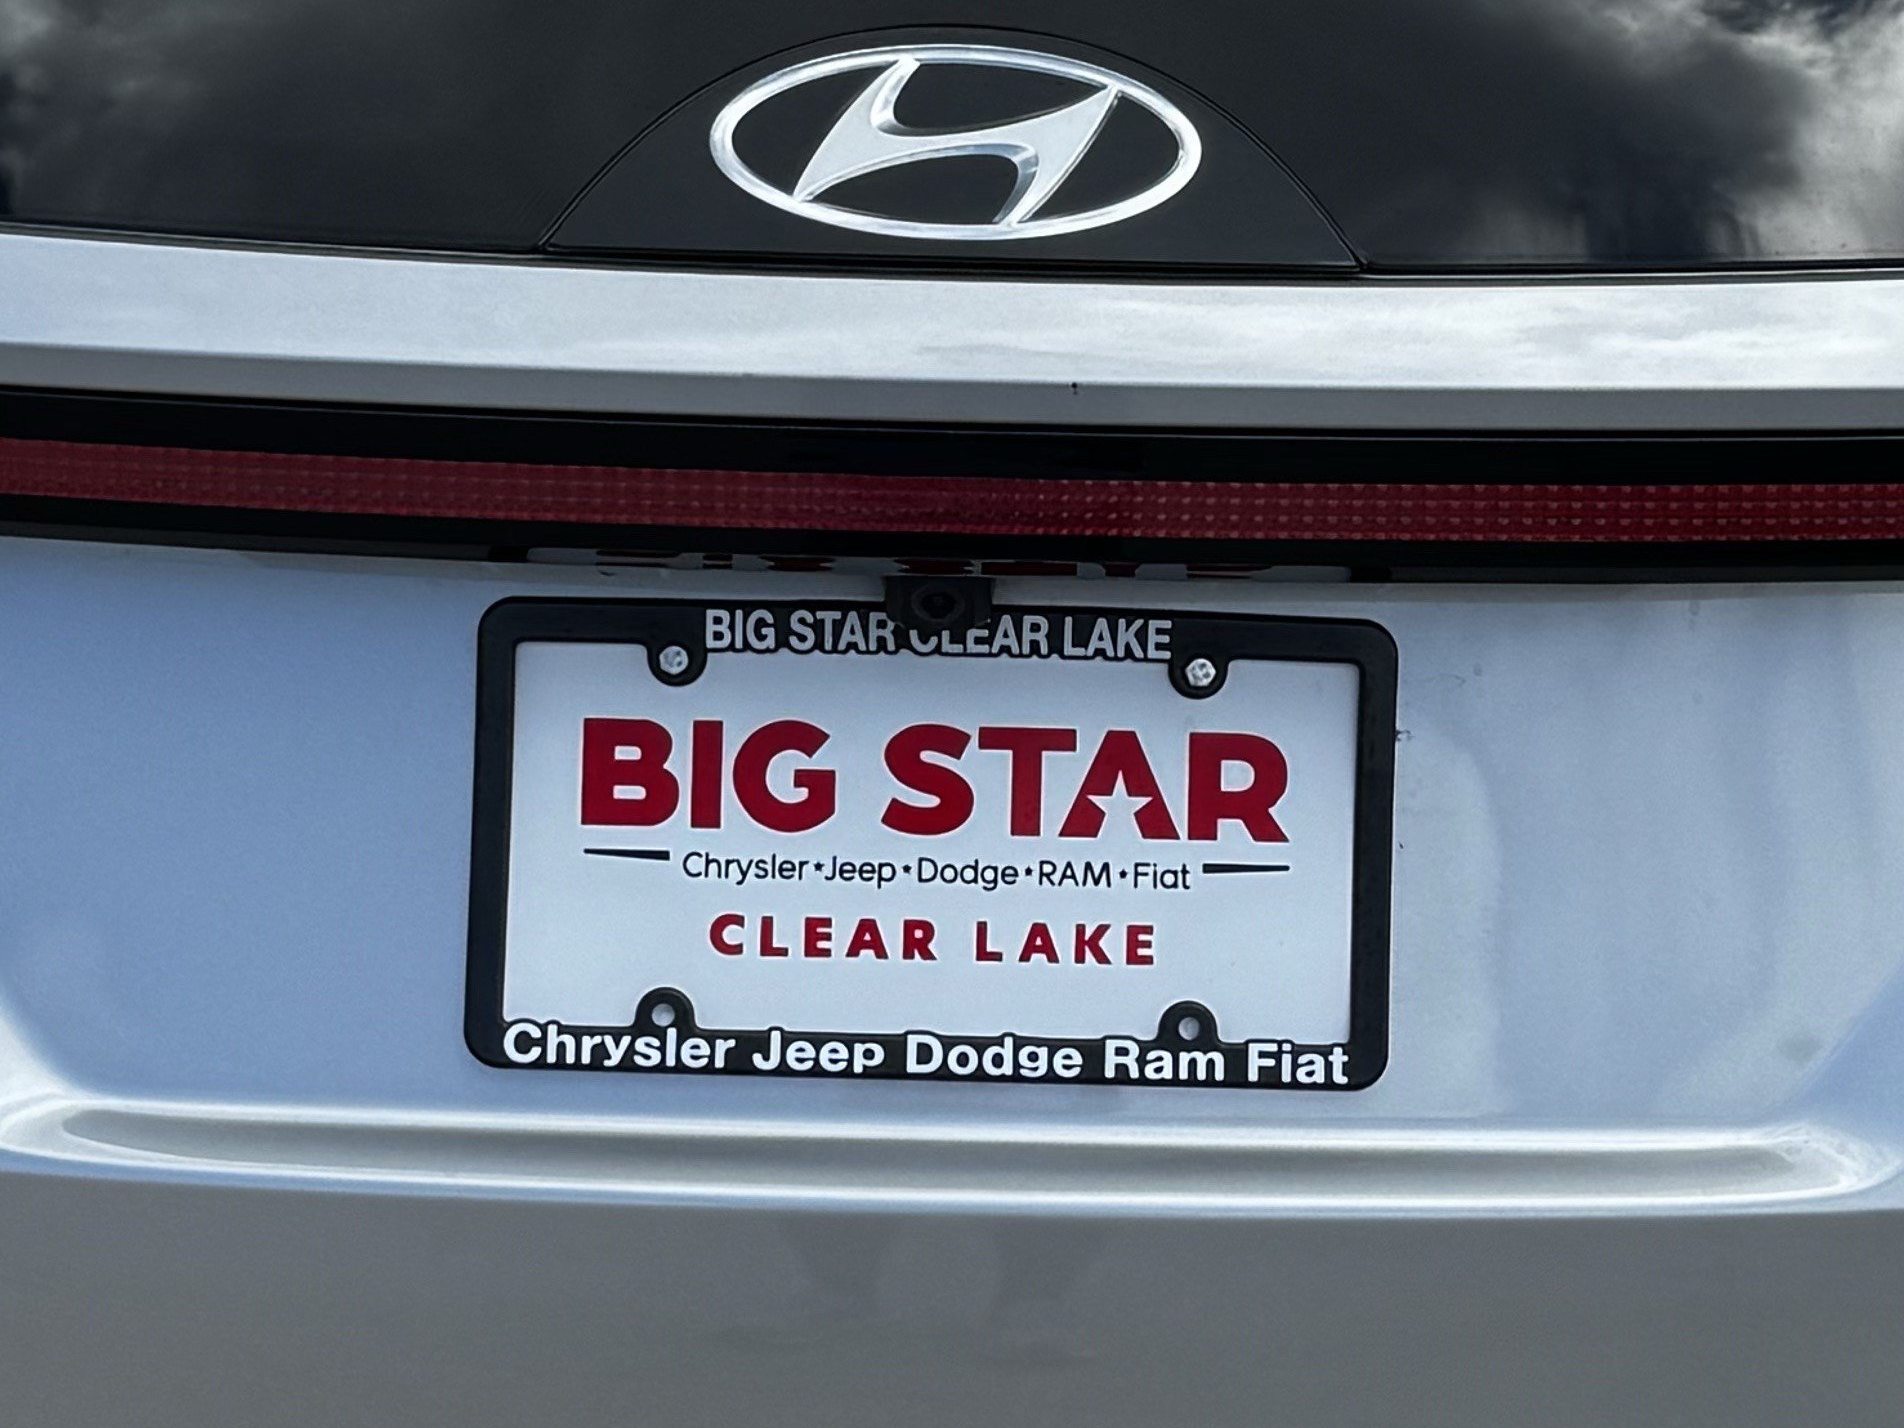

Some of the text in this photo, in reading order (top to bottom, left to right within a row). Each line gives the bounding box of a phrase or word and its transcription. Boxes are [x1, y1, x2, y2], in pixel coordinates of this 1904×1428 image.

[705, 608, 776, 651] BIG
[788, 609, 898, 653] STAR
[1062, 615, 1173, 661] LAKE
[581, 718, 1290, 843] BIG STAR
[682, 851, 1192, 893] Chrysler Jeep Dodge RAM Fiat
[709, 914, 1156, 966] CLEAR LAKE
[503, 1021, 1350, 1086] Chrysler Jeep Dodge Ram Fiat
